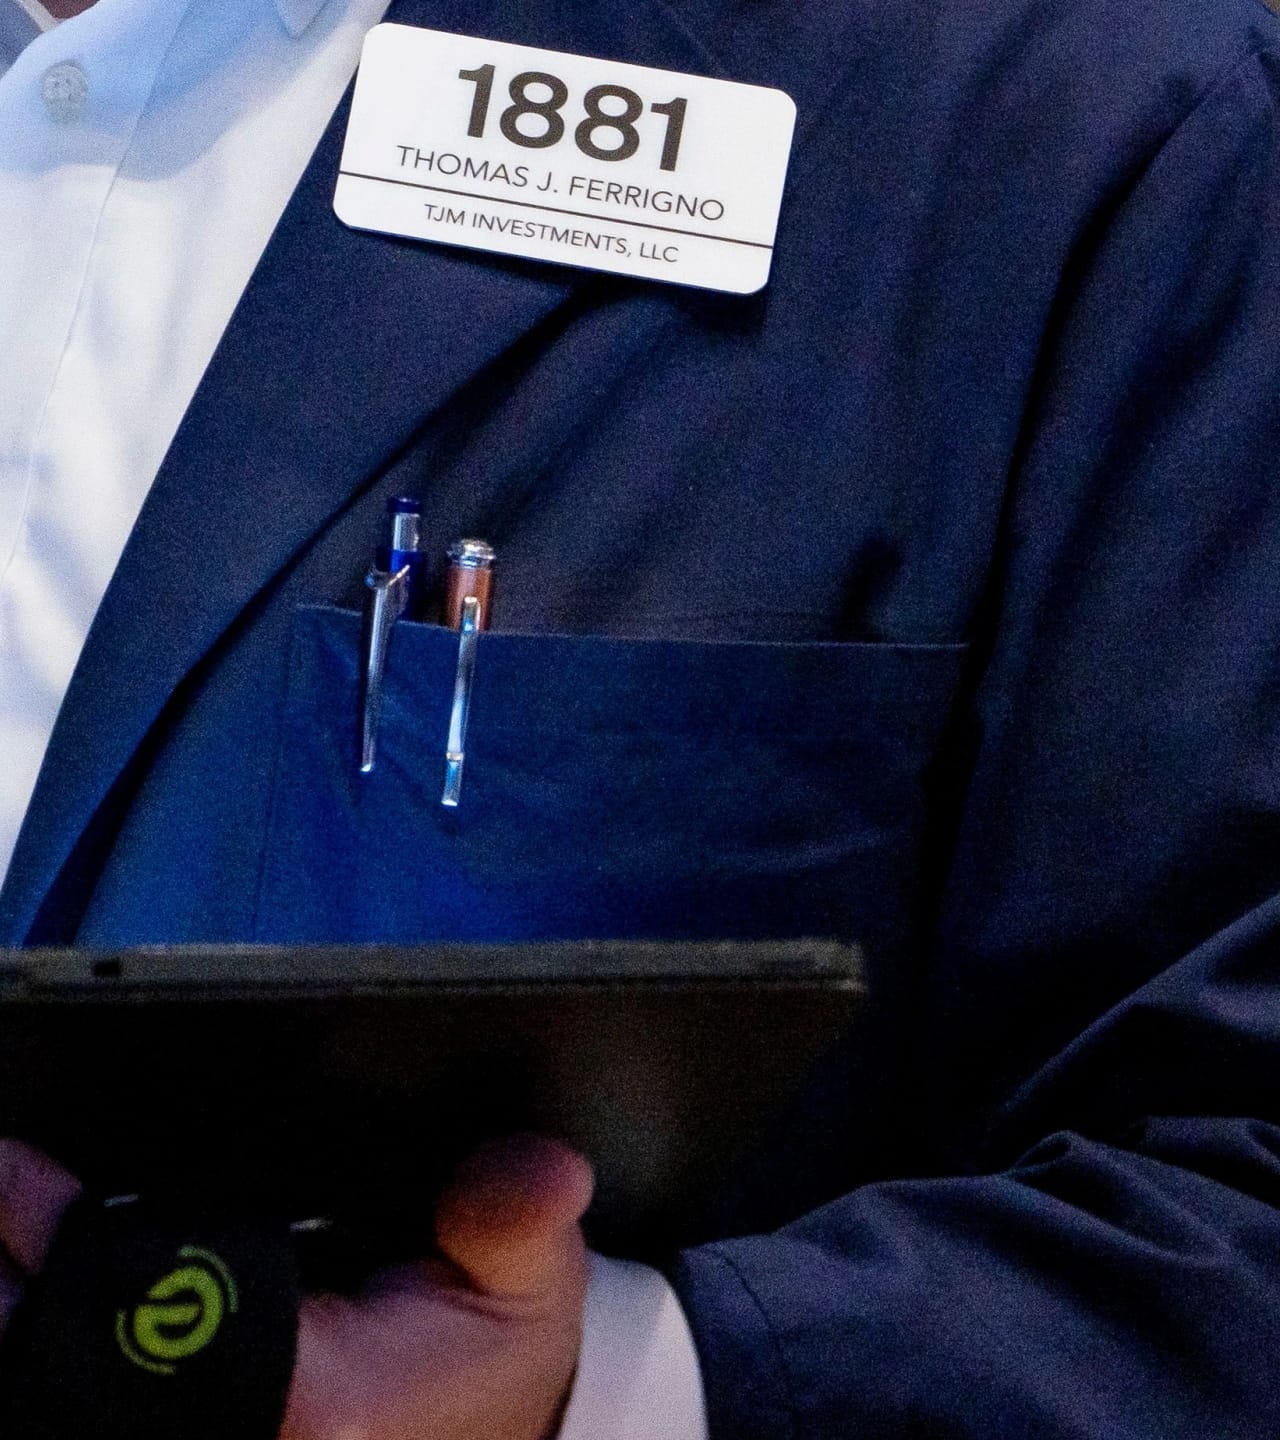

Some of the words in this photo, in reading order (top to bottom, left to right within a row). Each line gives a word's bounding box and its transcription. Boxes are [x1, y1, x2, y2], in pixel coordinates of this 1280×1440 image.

[458, 63, 688, 172] 1881
[397, 145, 529, 188] THOMAS
[536, 171, 558, 193] J.
[568, 175, 726, 221] FERRIGNO
[424, 203, 466, 226] TJM
[472, 213, 632, 258] INVESTMENTS,
[639, 242, 680, 264] LLC
